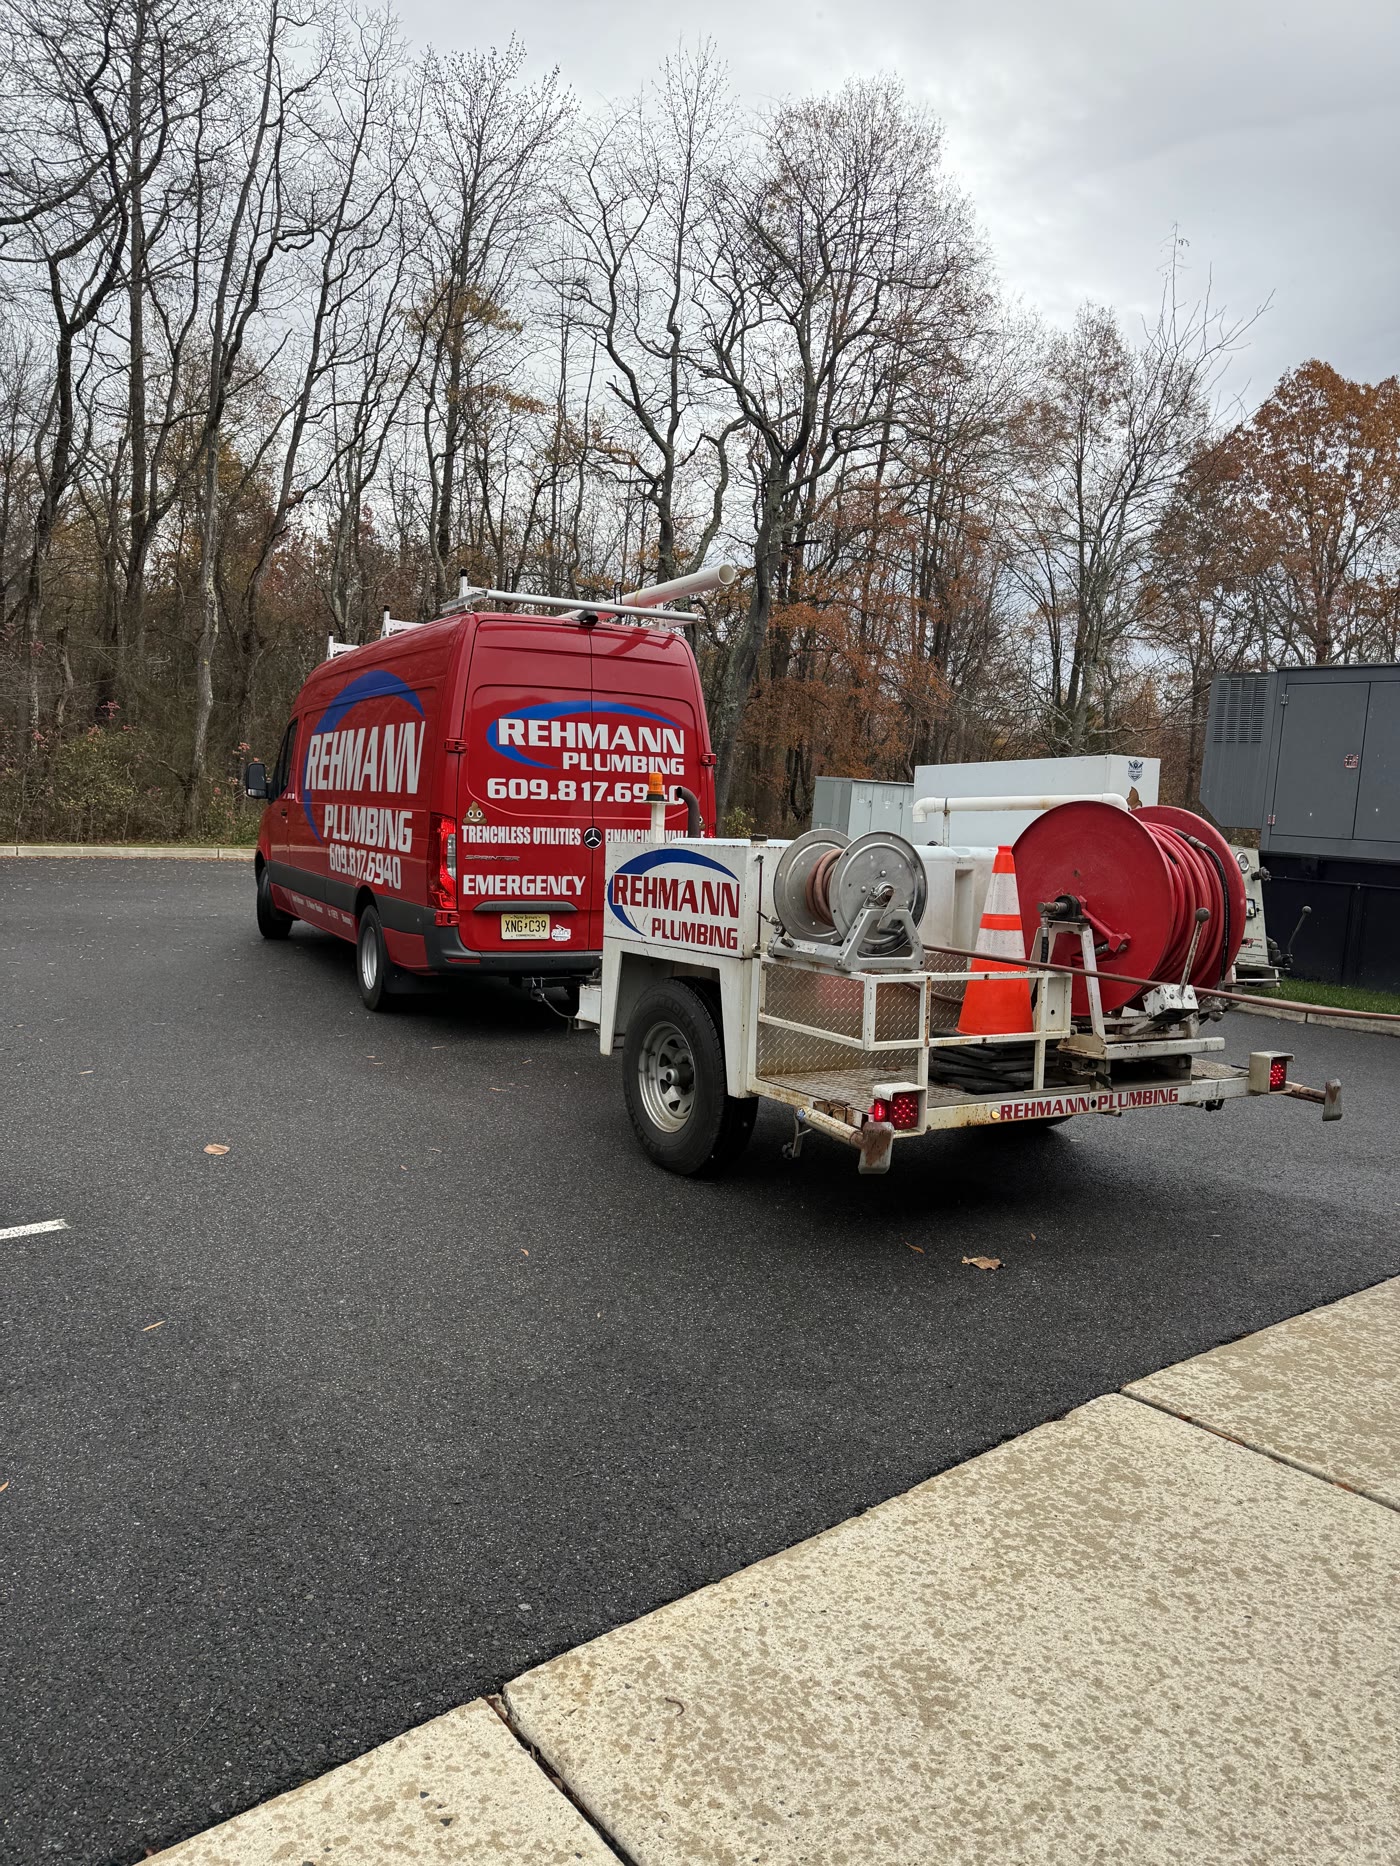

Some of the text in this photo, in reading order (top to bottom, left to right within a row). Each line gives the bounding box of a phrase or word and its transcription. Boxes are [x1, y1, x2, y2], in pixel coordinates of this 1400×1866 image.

[498, 718, 685, 755] REHMANN
[305, 721, 426, 794] REHMANN
[562, 751, 685, 776] PLUMBING
[487, 778, 686, 805] 609.817.690
[323, 804, 413, 853] PLUMBING
[461, 825, 581, 846] TRENCHLESS UTILITIES
[605, 828, 651, 843] FINANCIN
[329, 842, 402, 889] 609.817.6940
[463, 874, 586, 896] EMERGENCY
[612, 874, 741, 919] REHMANN
[505, 920, 547, 932] XNG C39
[651, 917, 738, 950] PLUMBING
[1000, 1087, 1179, 1121] REHMANN PLUMBING
